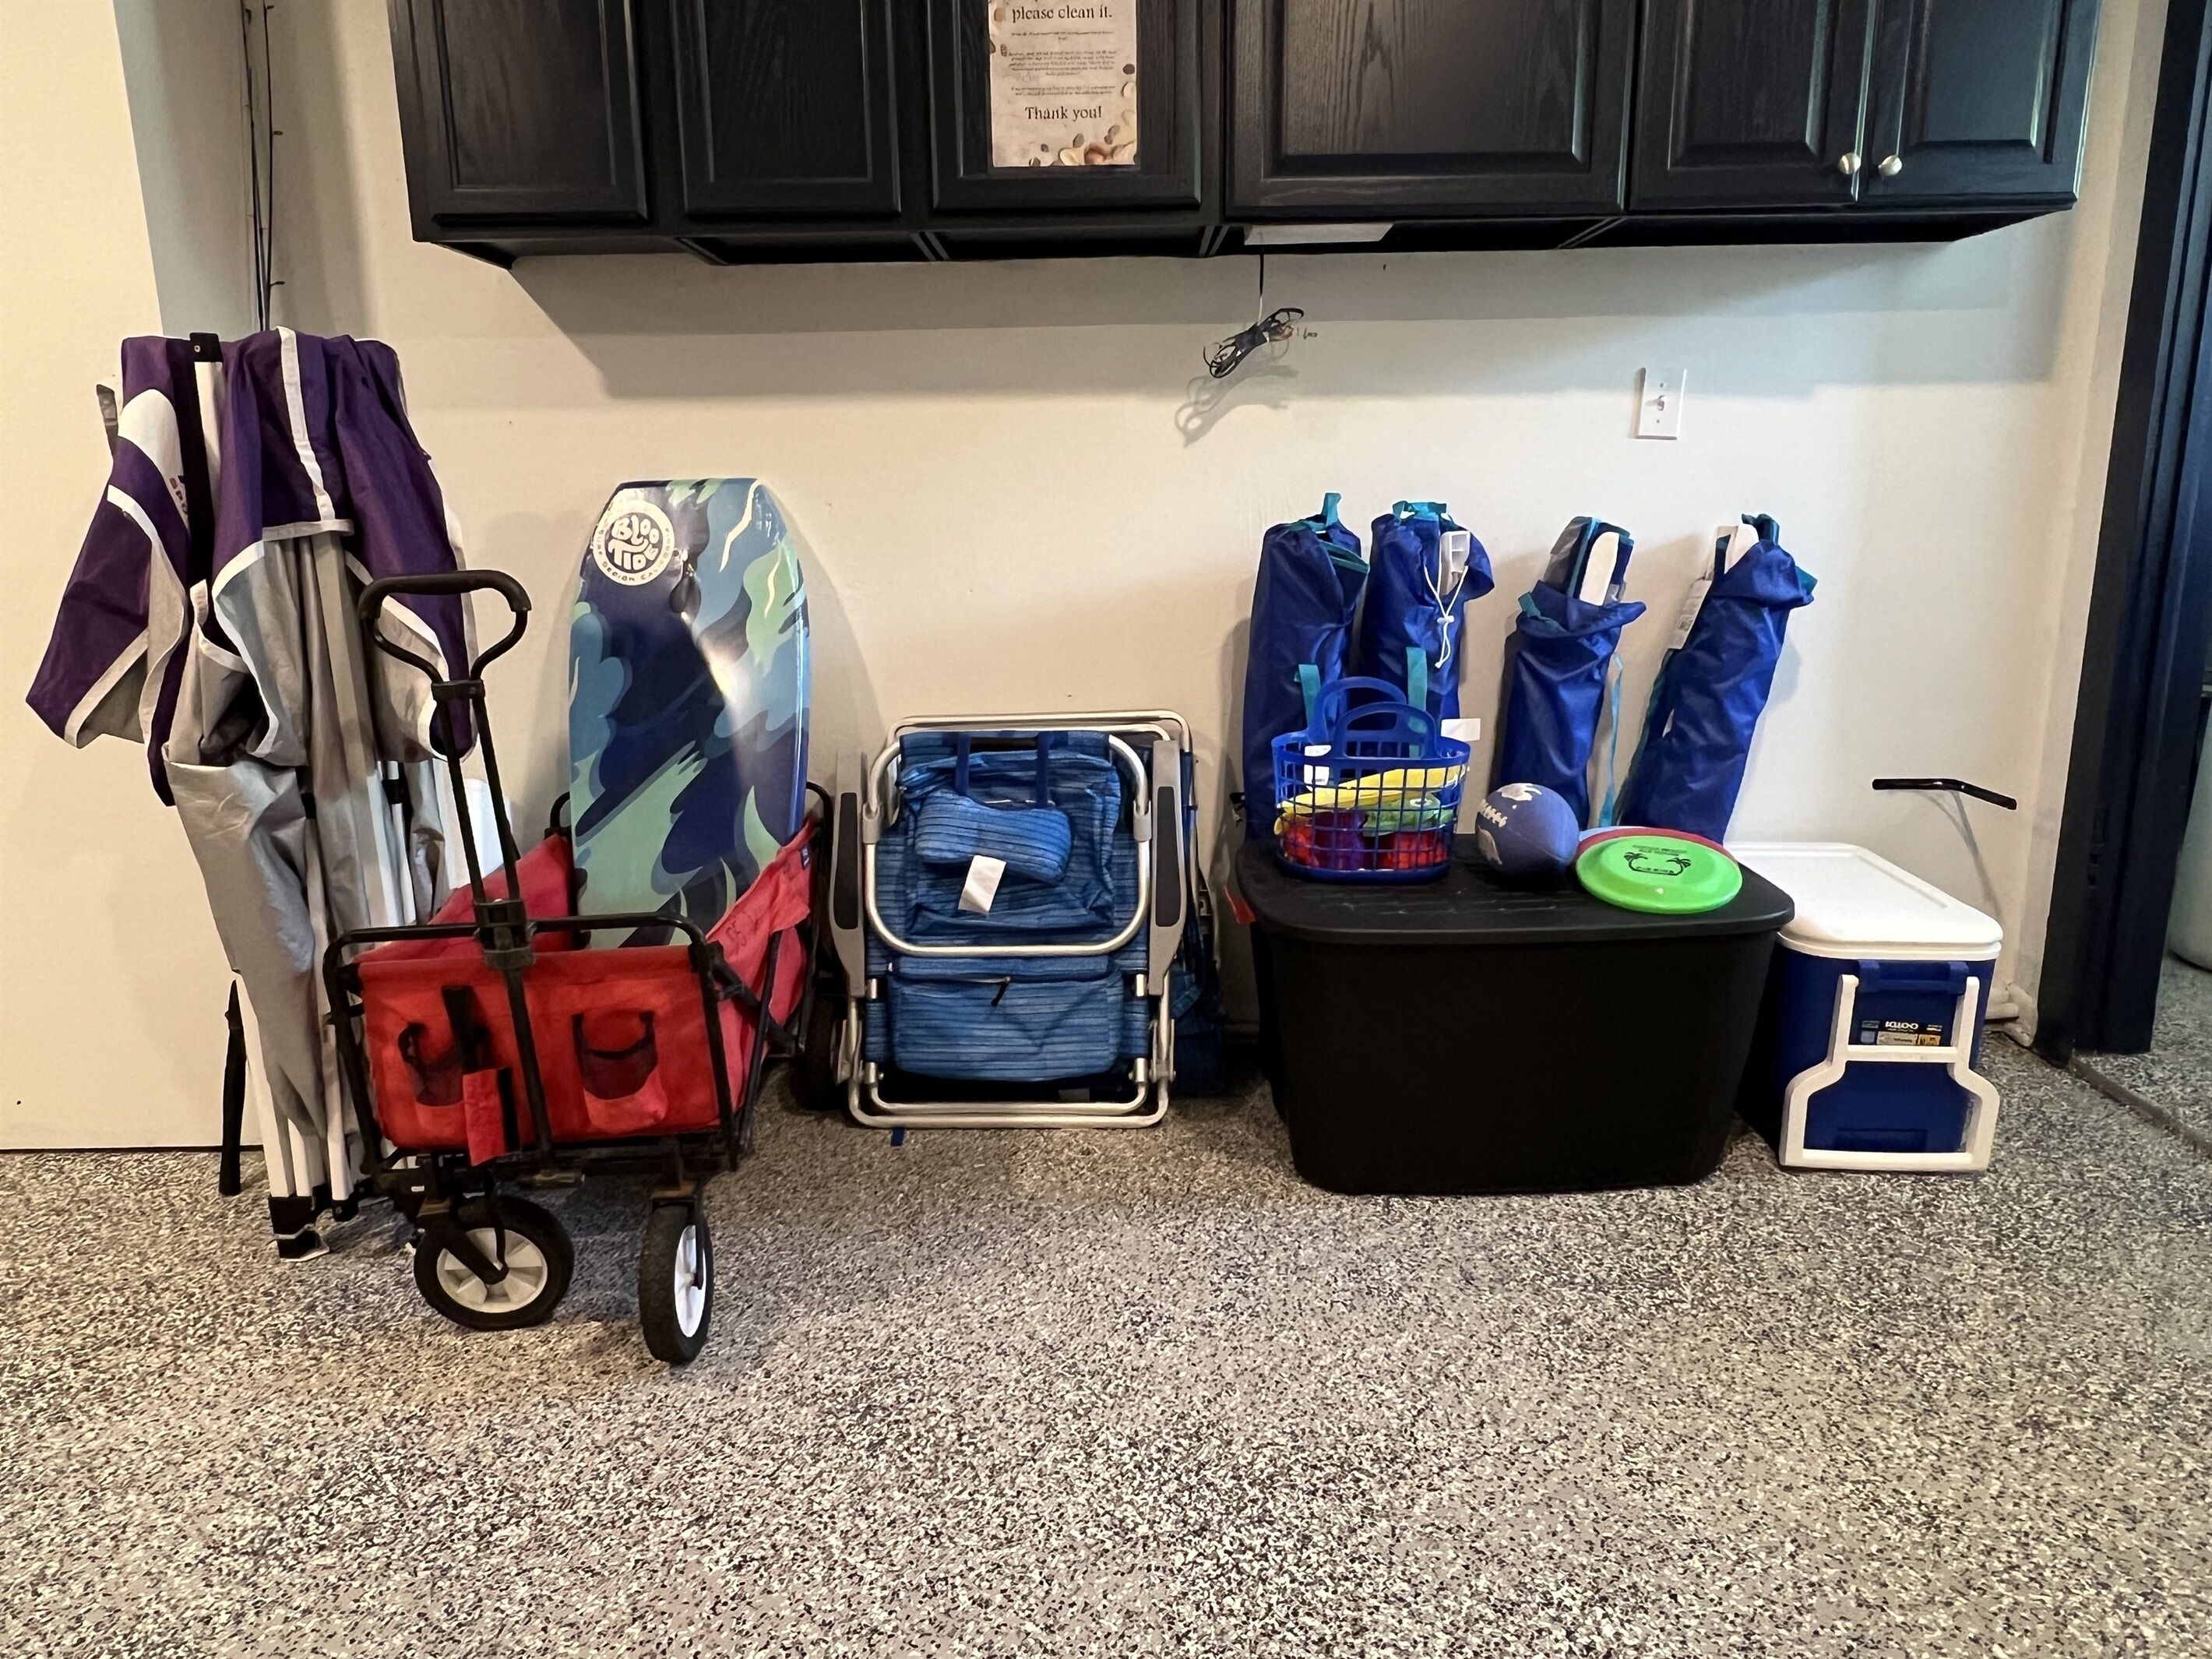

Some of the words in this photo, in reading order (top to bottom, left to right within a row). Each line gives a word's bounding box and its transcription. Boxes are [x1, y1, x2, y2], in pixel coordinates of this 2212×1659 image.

[1012, 6, 1054, 23] please
[1058, 5, 1094, 19] clean
[1099, 3, 1113, 19] it.
[1024, 105, 1069, 119] Thank
[1072, 104, 1102, 122] you!
[608, 537, 659, 571] TIDE
